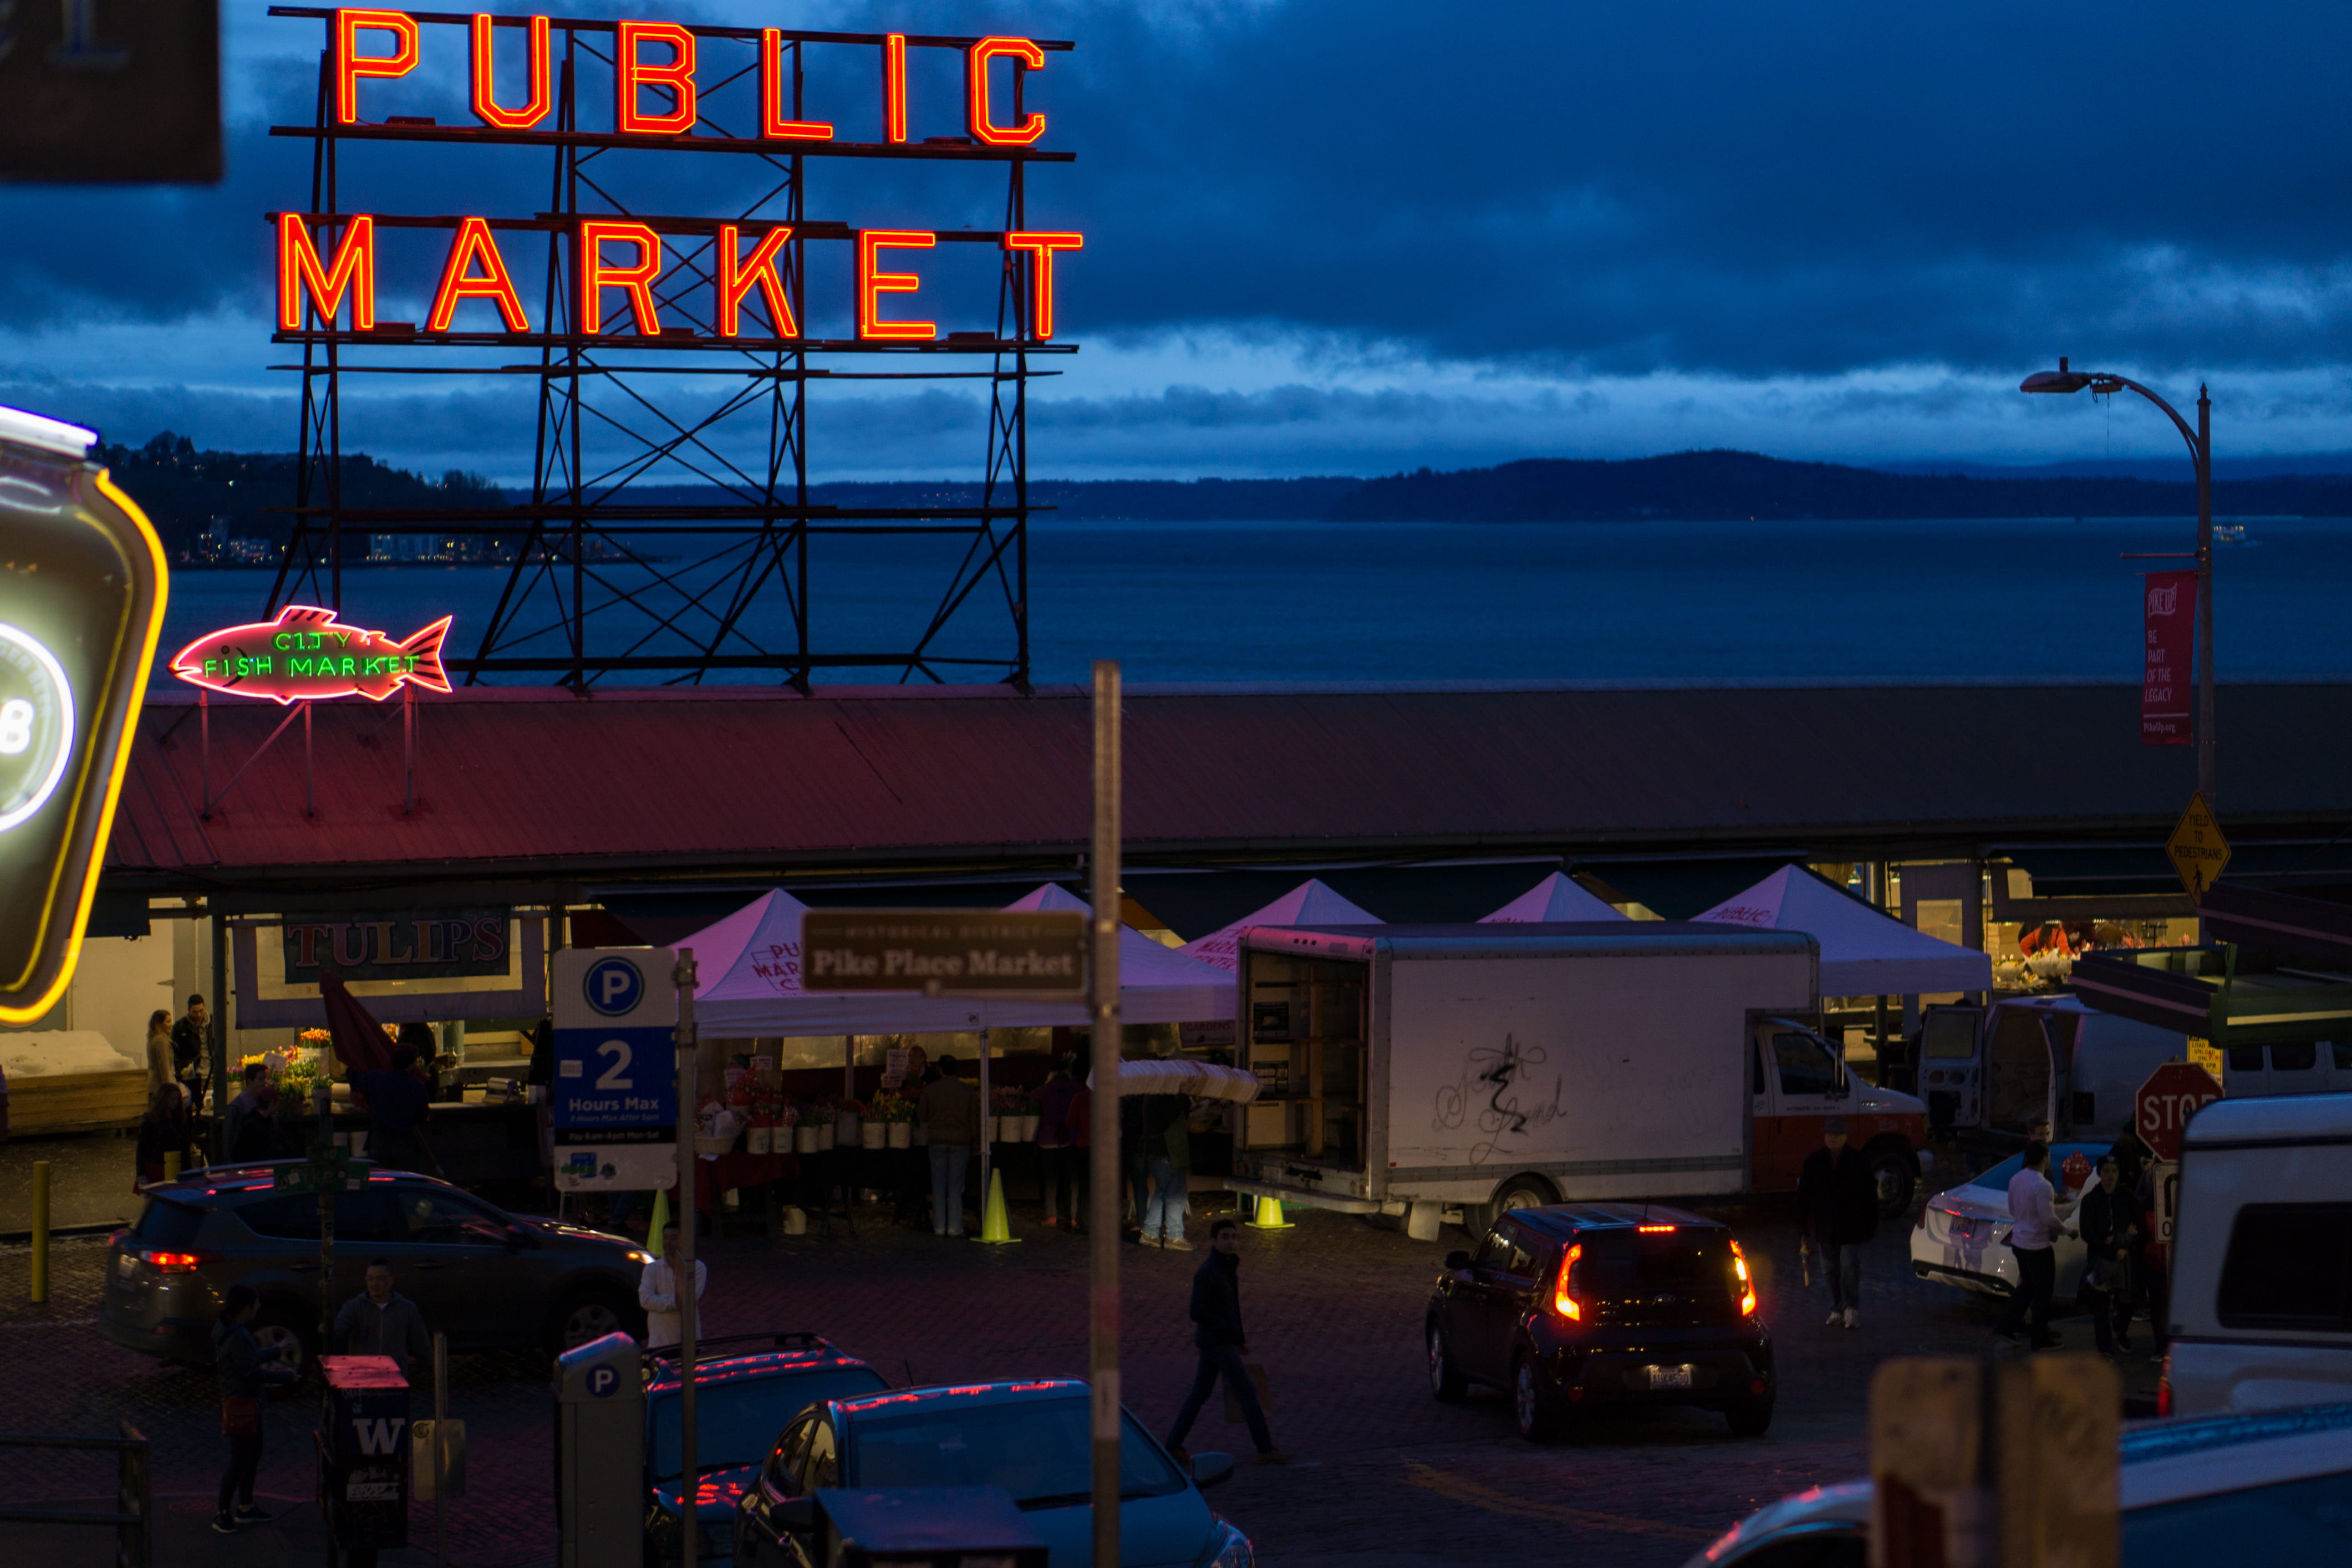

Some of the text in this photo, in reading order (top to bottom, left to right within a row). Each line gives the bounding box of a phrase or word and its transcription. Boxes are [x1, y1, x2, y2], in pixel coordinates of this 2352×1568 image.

[335, 8, 1046, 146] PUBLIC
[279, 212, 1083, 341] MARKET
[2148, 589, 2163, 612] PIKE
[273, 632, 351, 650] CITY
[2147, 629, 2157, 644] BE
[203, 654, 420, 678] FISH MARKET
[2147, 648, 2166, 663] PART
[2147, 667, 2171, 683] OF THE
[2145, 687, 2172, 703] LEGACY
[2188, 814, 2210, 827] YIELD
[2193, 831, 2203, 843] TO
[2174, 845, 2223, 861] PEDESTRIANS
[286, 916, 505, 968] TULIPS
[811, 948, 1074, 977] Pike Place Market
[602, 970, 631, 1005] P
[595, 1038, 634, 1091] 2
[568, 1097, 659, 1112] Hours Max
[595, 1369, 613, 1393] P
[352, 1418, 406, 1455] W
